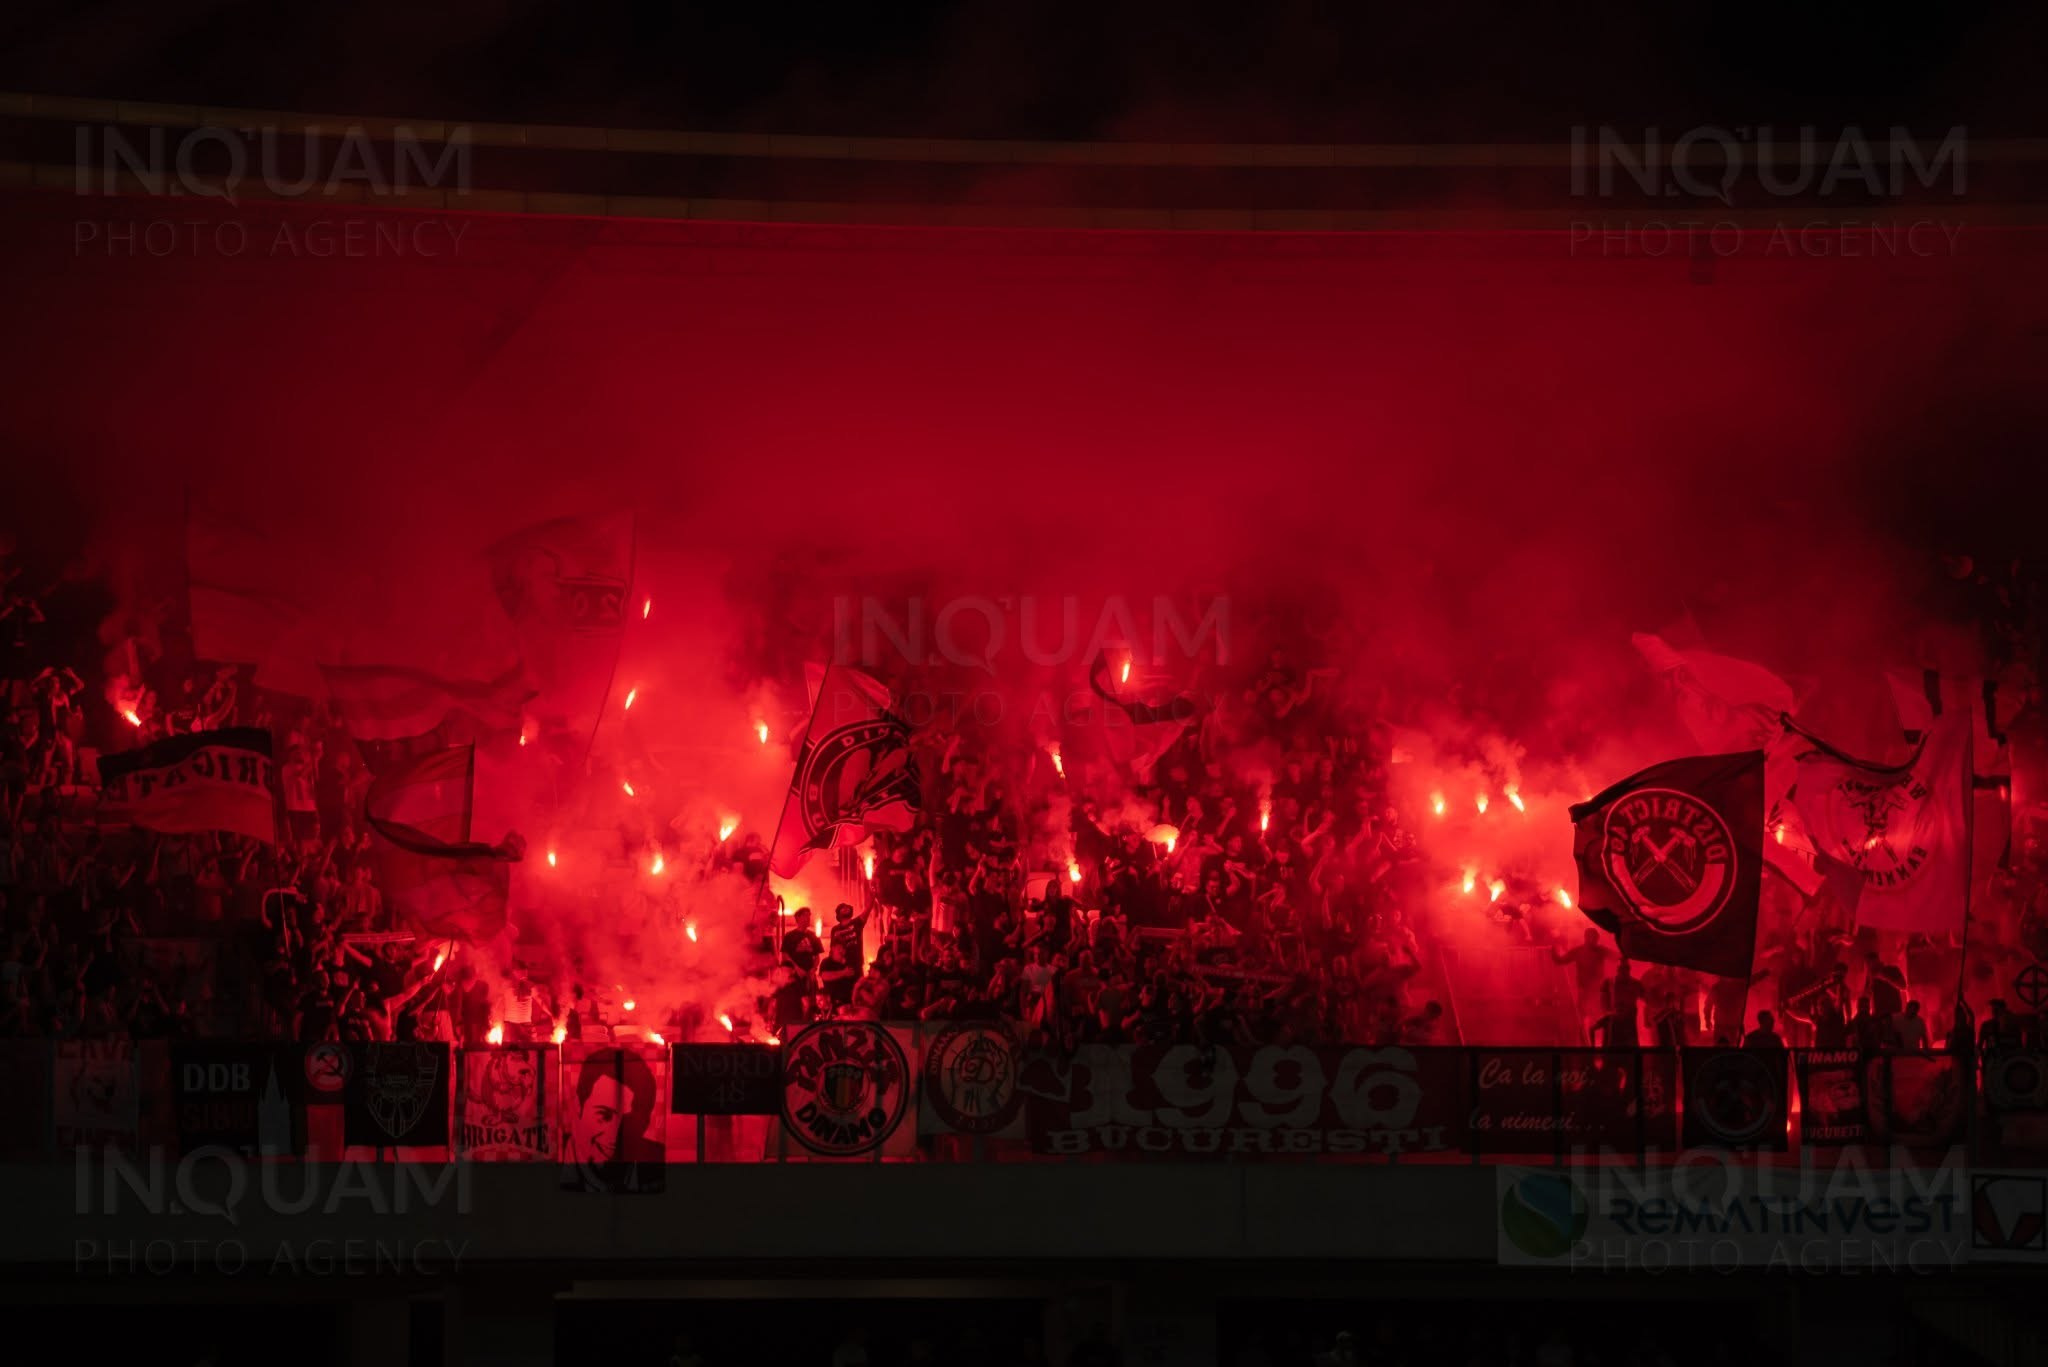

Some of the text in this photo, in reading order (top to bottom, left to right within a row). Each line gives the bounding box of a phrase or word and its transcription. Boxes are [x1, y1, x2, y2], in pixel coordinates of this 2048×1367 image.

[183, 1063, 251, 1092] DDB
[680, 1050, 776, 1077] NORD
[1478, 1057, 1513, 1089] Ca
[1522, 1060, 1545, 1087] la
[1070, 1044, 1425, 1128] 1996
[795, 1101, 887, 1145] DINAMO
[460, 1124, 549, 1154] BRIGATE
[1048, 1126, 1449, 1154] BUCURESTI
